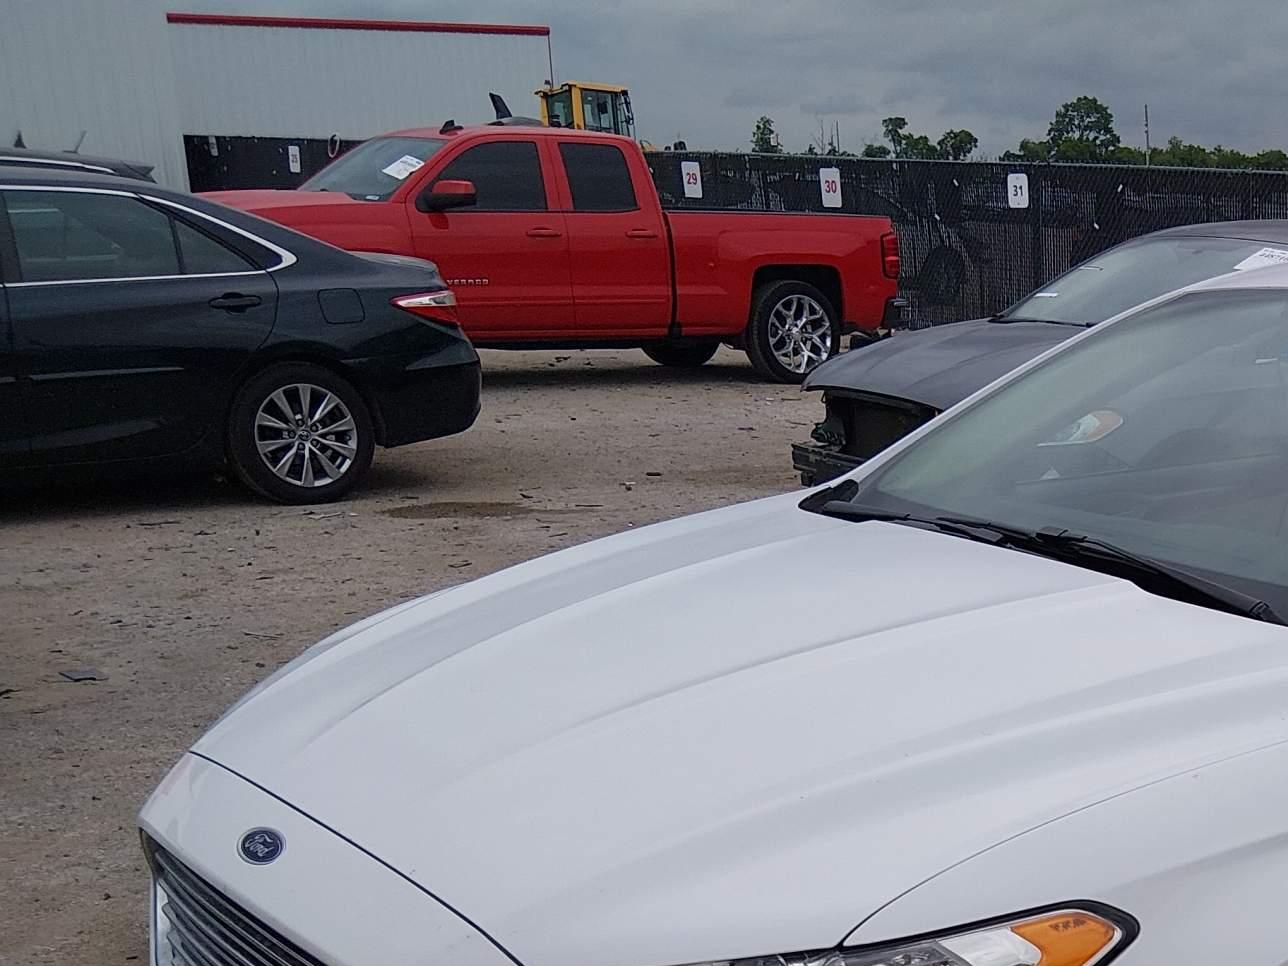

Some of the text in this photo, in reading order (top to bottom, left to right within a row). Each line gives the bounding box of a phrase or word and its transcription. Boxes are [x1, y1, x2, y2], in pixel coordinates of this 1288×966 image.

[686, 172, 698, 186] 29
[825, 180, 837, 194] 30
[1012, 184, 1023, 197] 31
[244, 833, 276, 857] Ford
